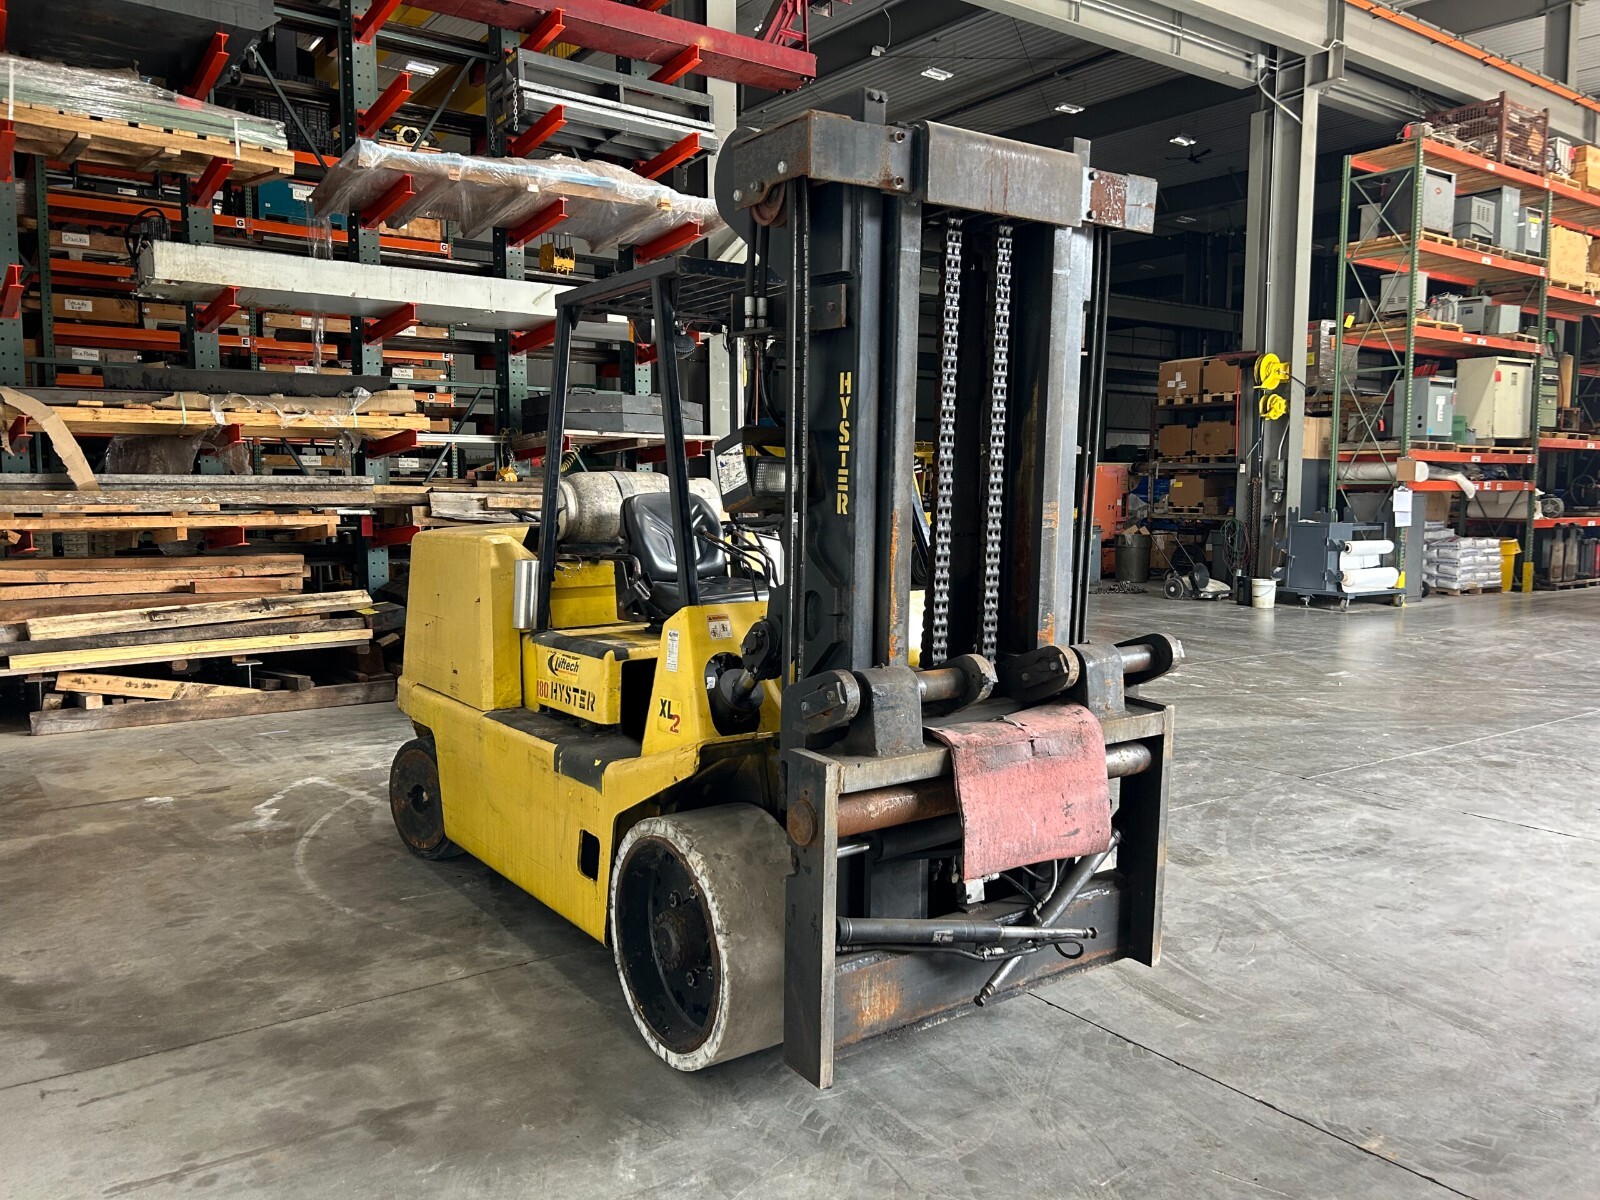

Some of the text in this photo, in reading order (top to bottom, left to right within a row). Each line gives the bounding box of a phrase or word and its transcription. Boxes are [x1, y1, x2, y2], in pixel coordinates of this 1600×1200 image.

[236, 219, 244, 227] G
[242, 338, 249, 346] E
[836, 371, 852, 515] HYSTER
[551, 682, 596, 712] HYSTER
